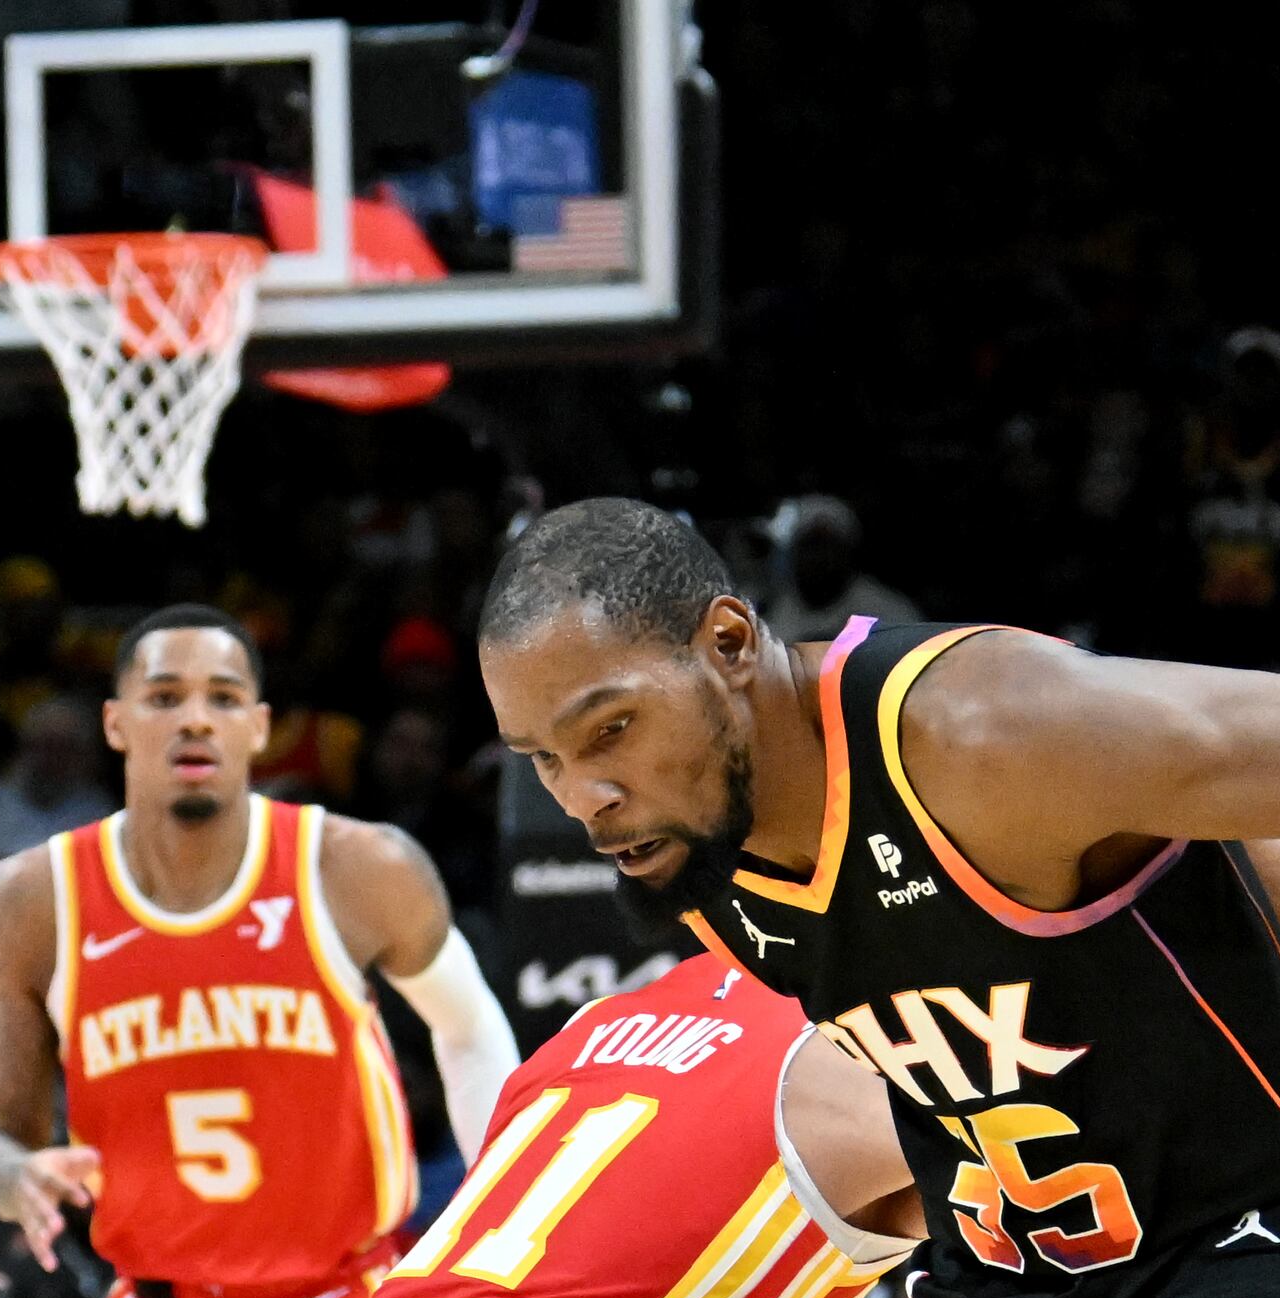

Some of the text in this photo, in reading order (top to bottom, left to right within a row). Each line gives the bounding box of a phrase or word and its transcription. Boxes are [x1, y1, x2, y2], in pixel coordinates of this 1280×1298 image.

[877, 875, 938, 909] PayPal
[79, 985, 336, 1081] ATLANTA
[571, 1012, 744, 1075] YOUNG
[165, 1087, 263, 1202] 5
[383, 1087, 659, 1290] 11
